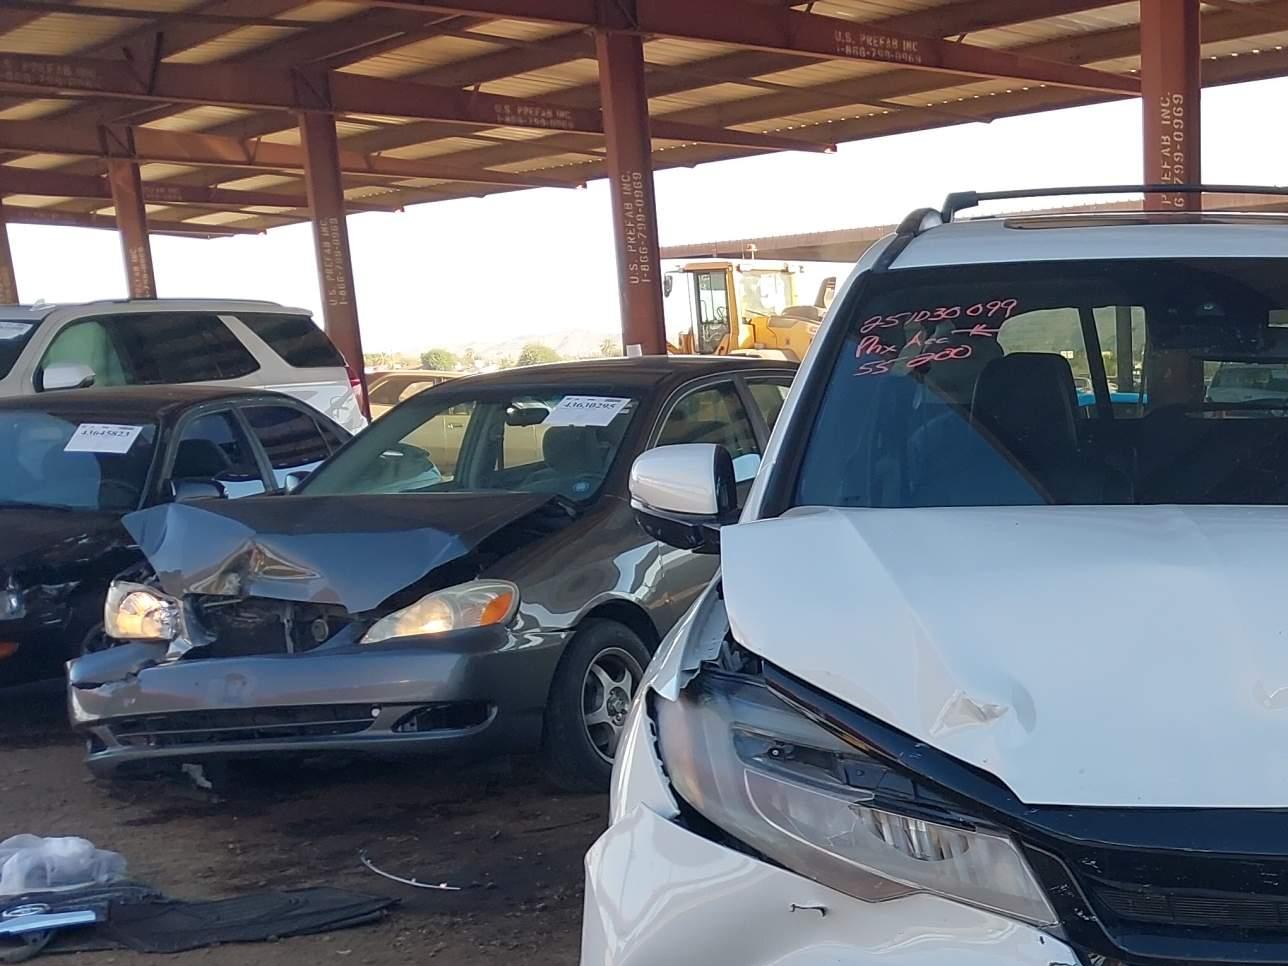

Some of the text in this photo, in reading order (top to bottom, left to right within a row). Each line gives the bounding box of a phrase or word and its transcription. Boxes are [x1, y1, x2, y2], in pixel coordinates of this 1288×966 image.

[860, 34, 898, 49] PREFAB
[1160, 91, 1171, 125] INC.
[624, 202, 637, 252] PREFAB
